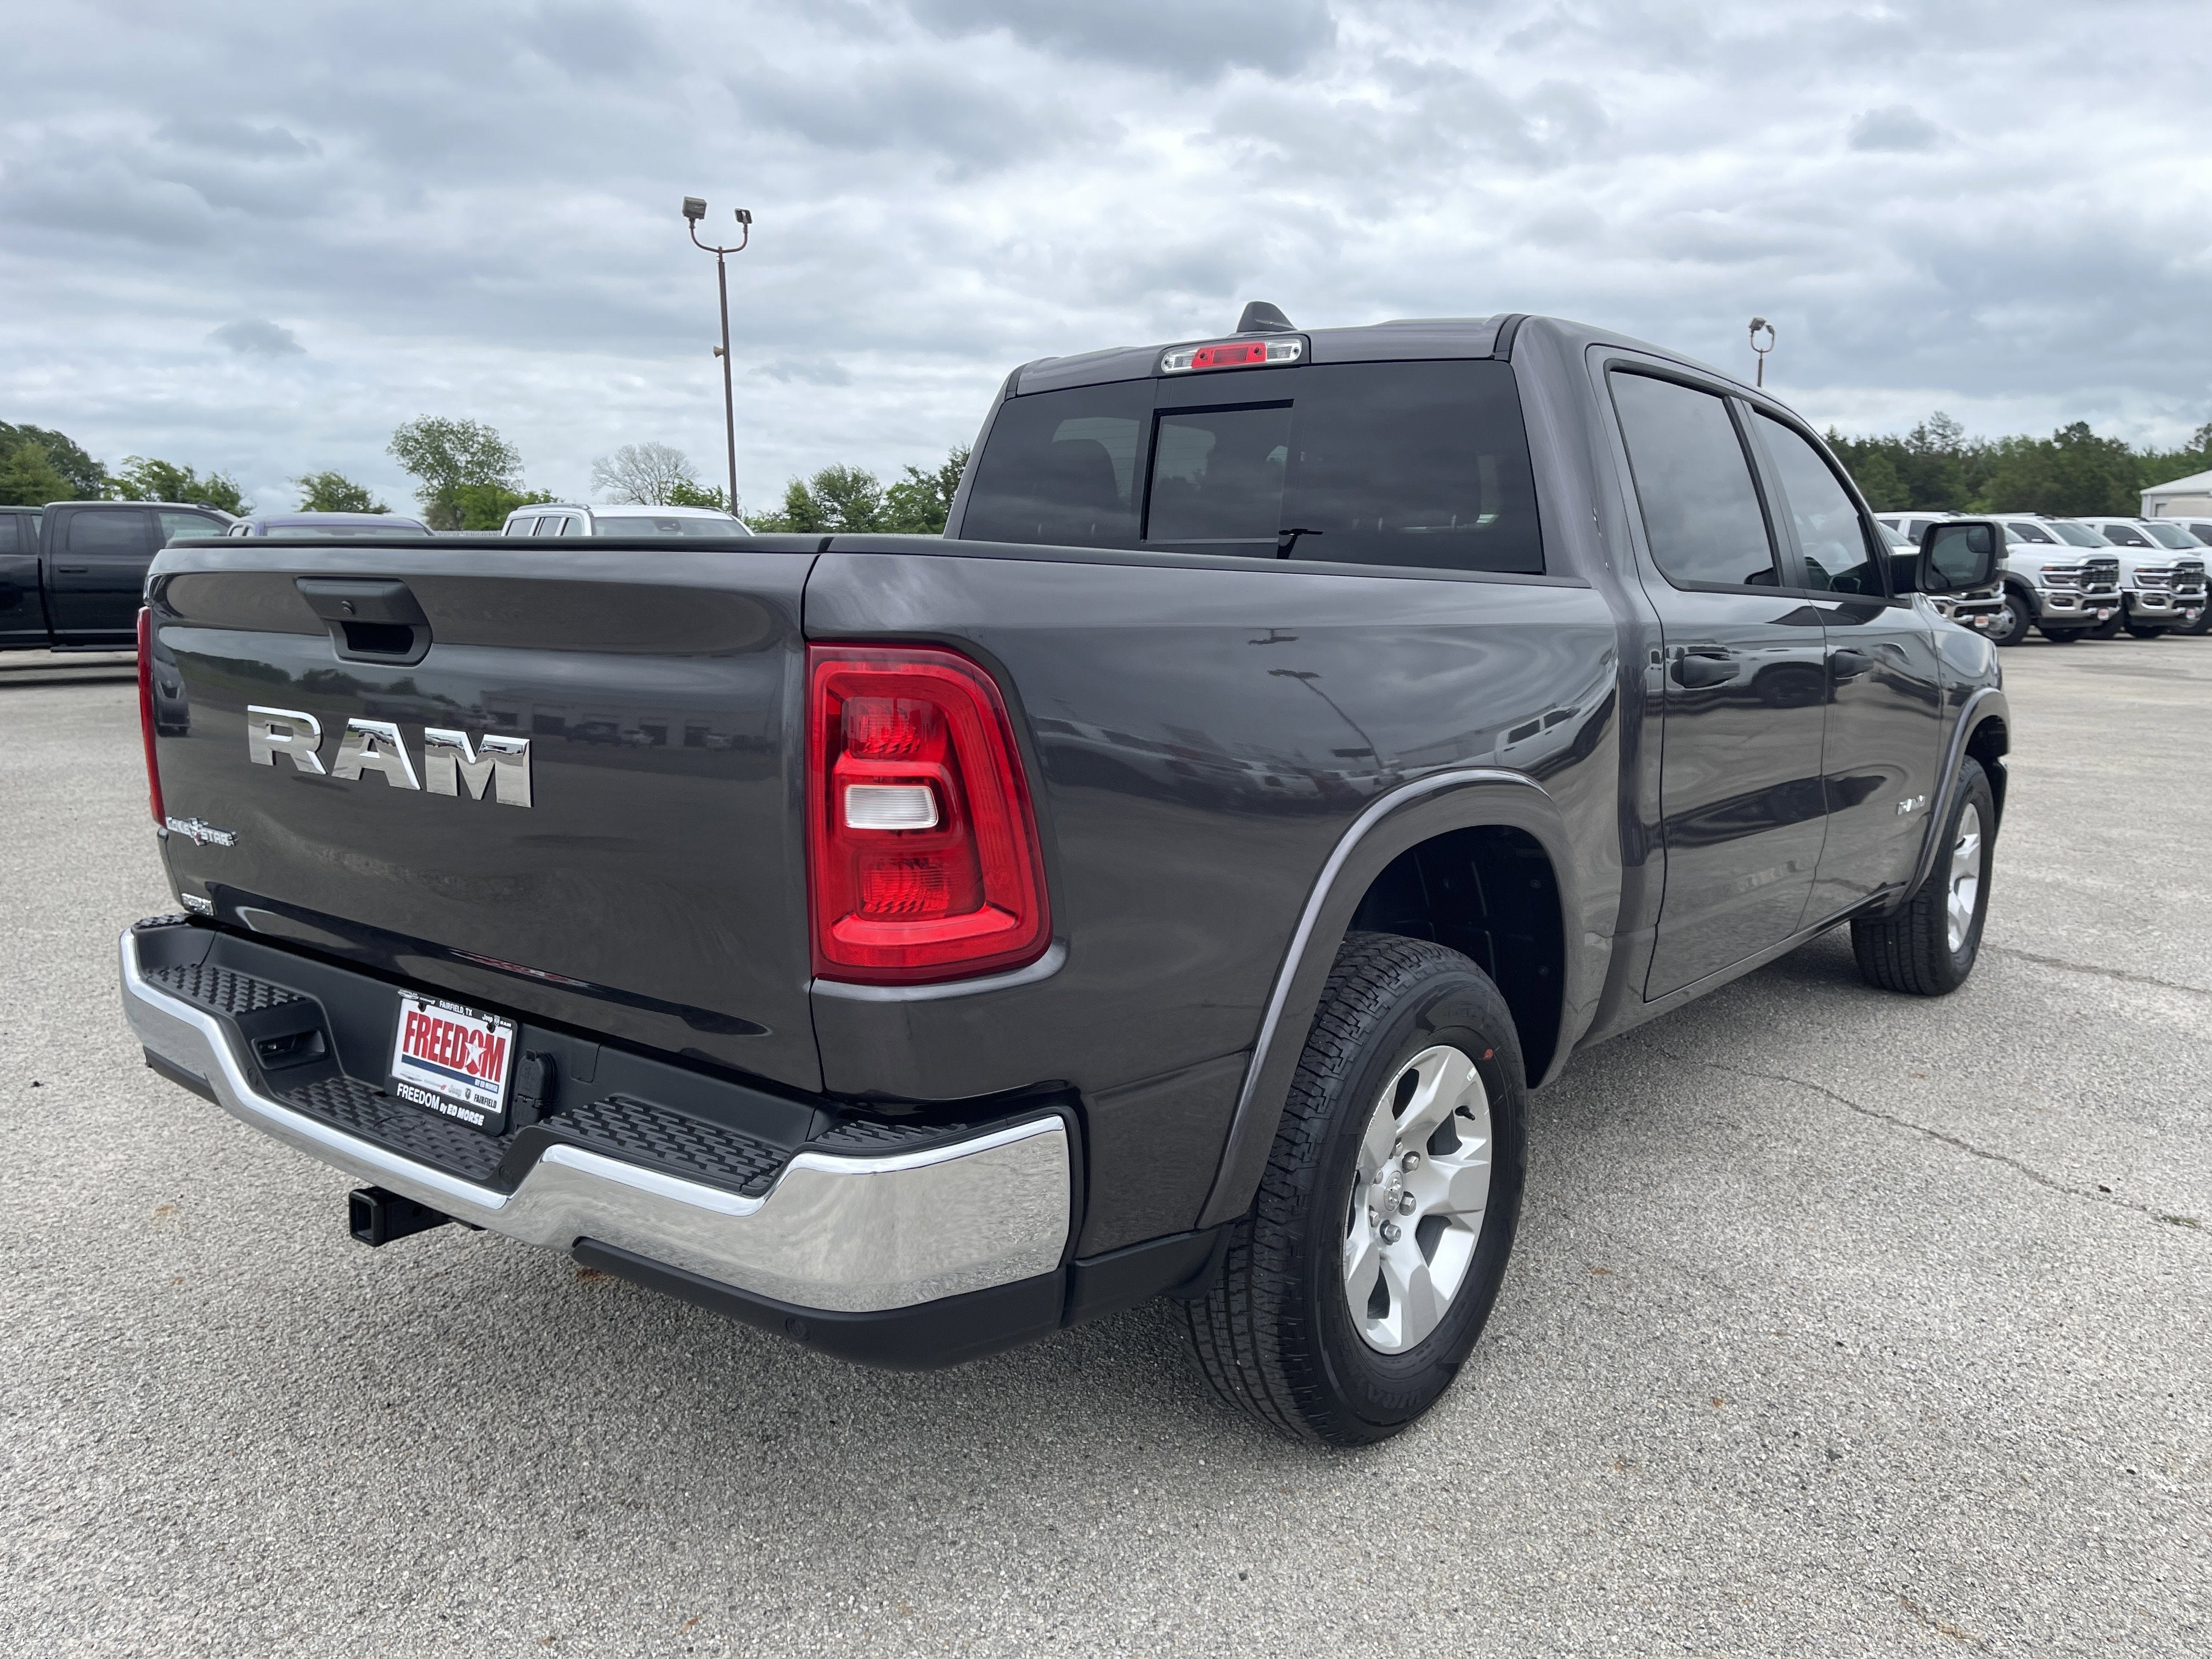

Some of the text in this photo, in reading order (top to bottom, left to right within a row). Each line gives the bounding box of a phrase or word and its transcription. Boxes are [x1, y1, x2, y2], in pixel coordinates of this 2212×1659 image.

[247, 705, 532, 808] RAM
[199, 826, 235, 847] STAR
[466, 1008, 473, 1017] TX
[482, 1014, 493, 1023] Jeep
[403, 1011, 506, 1083] FREEDOM
[397, 1082, 485, 1126] FREEDOM by ED MORSE
[474, 1093, 497, 1109] FAIRFIELD
